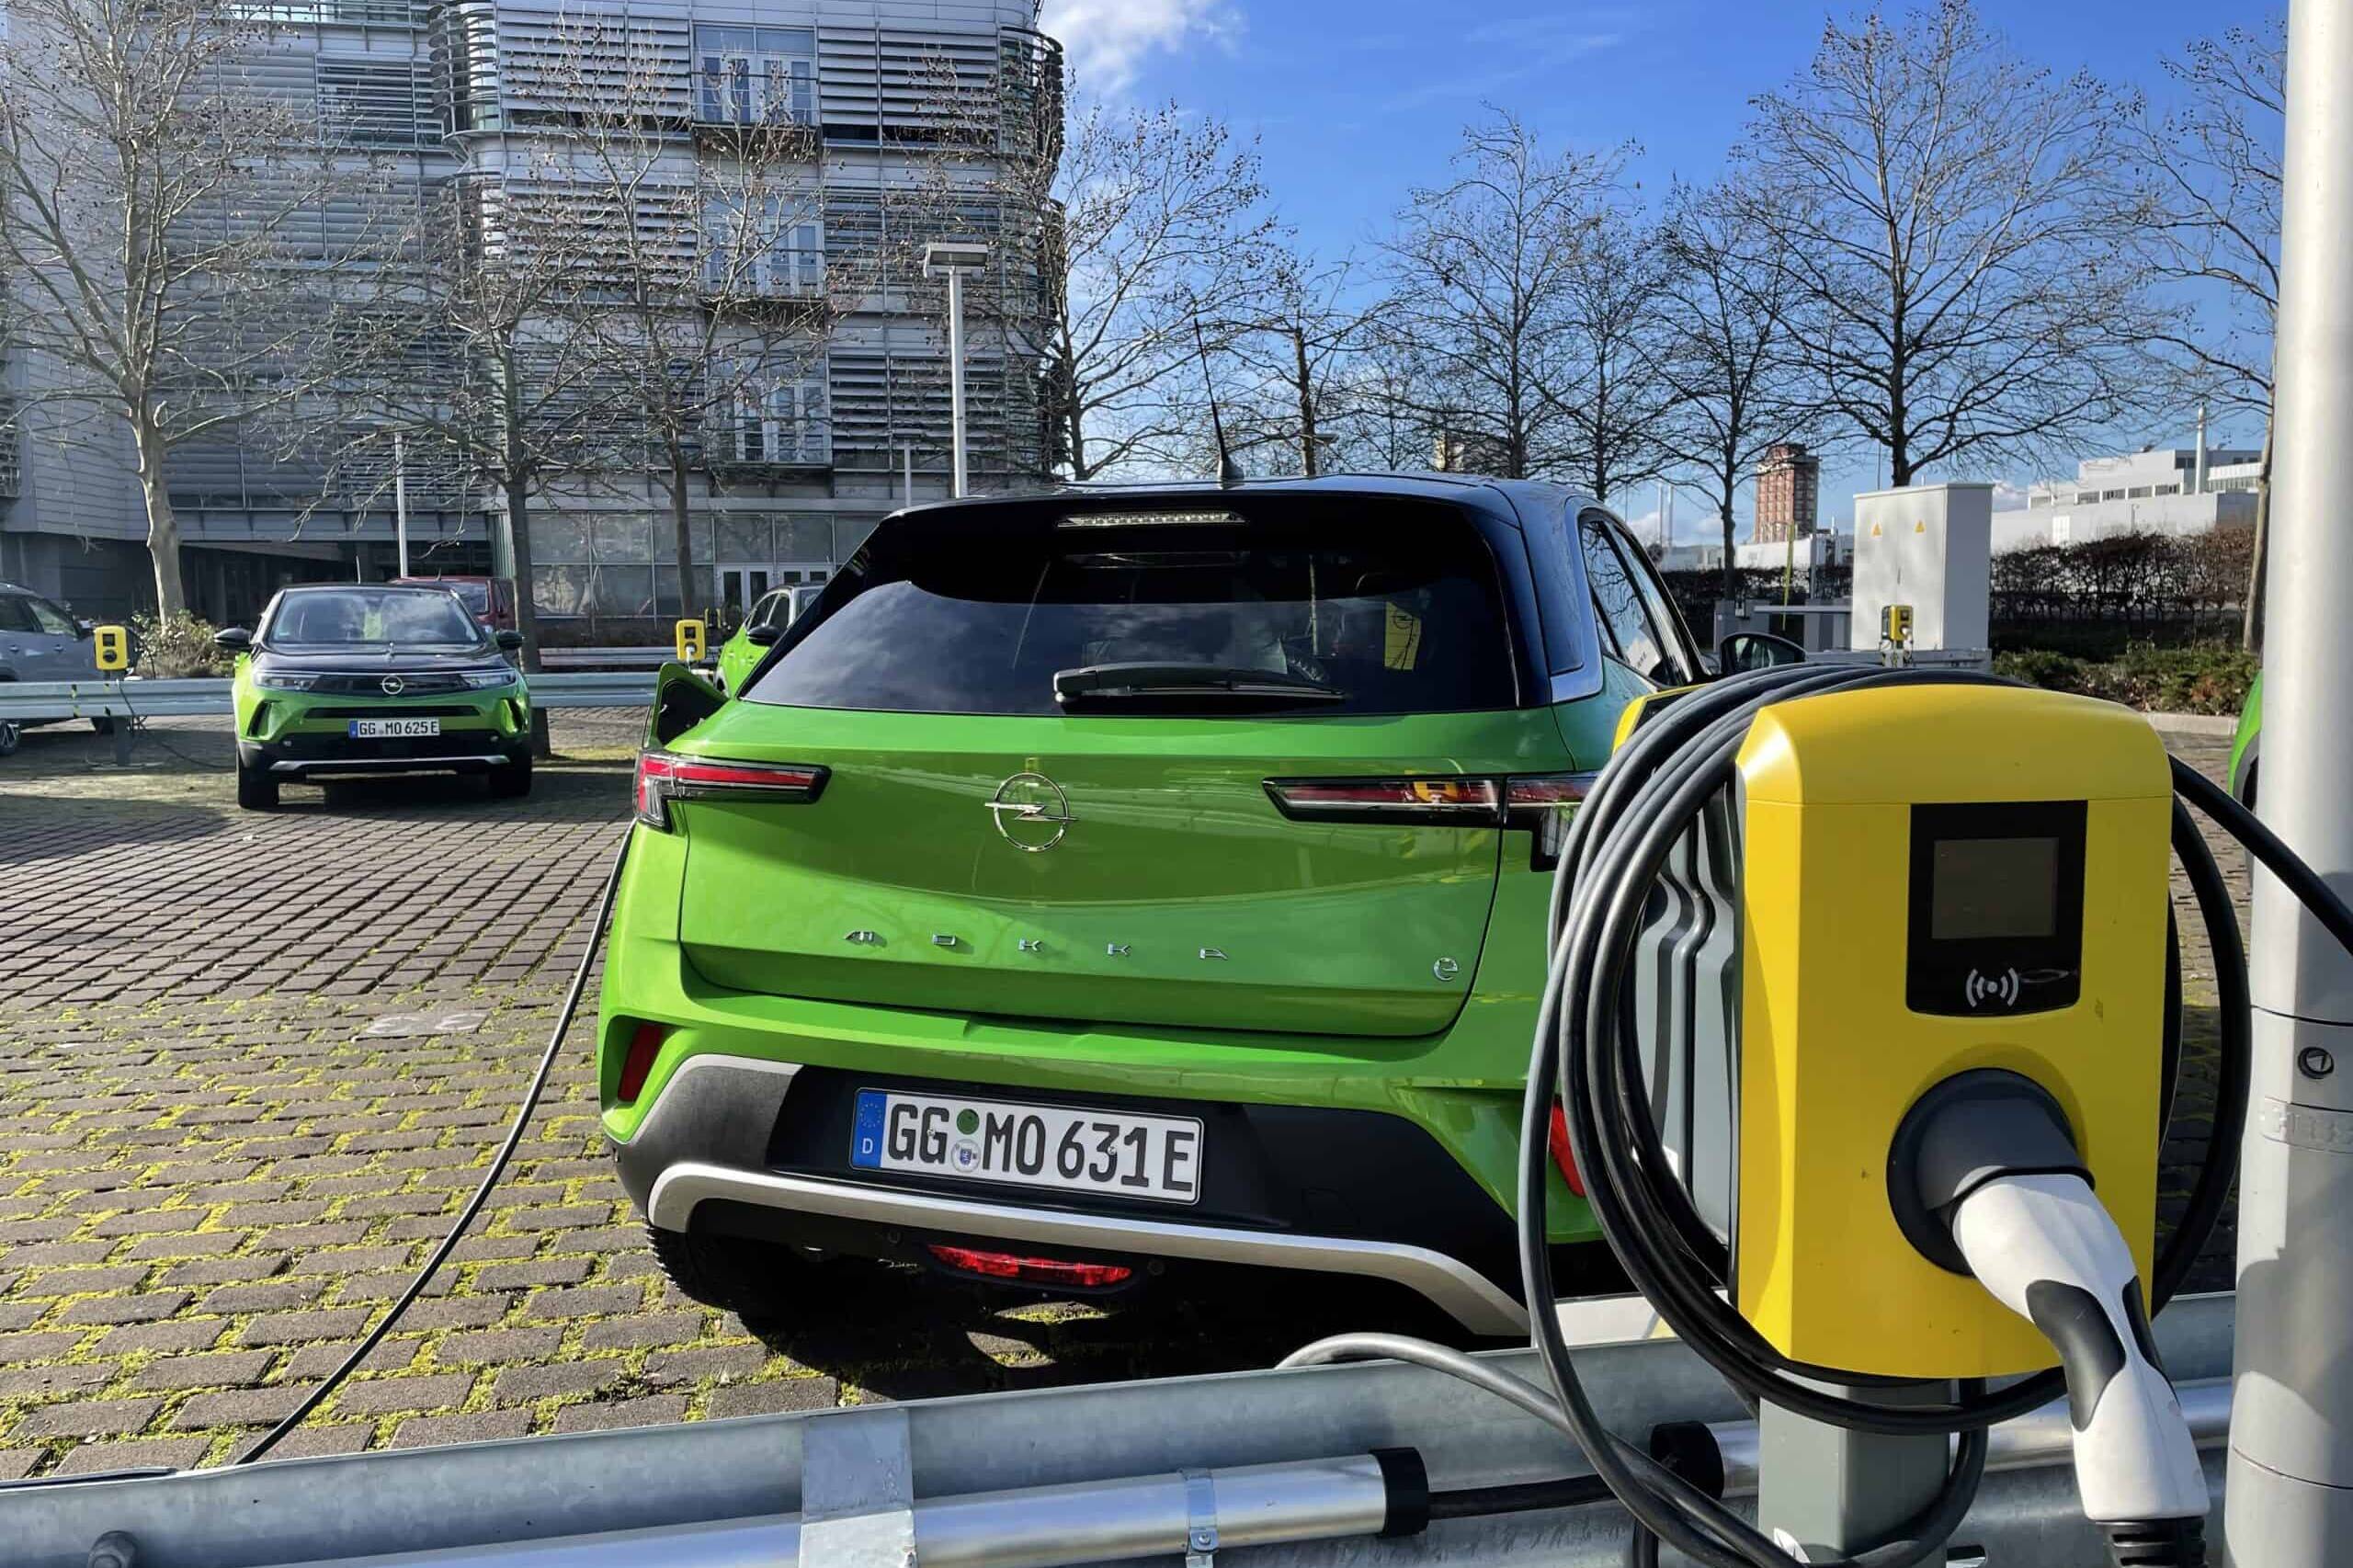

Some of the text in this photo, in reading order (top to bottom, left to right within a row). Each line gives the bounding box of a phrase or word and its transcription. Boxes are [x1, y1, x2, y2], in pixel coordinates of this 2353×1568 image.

[359, 722, 376, 735] GG
[385, 722, 402, 735] MO
[862, 1138, 873, 1153] D
[887, 1103, 950, 1165] GG
[982, 1112, 1046, 1176] MO
